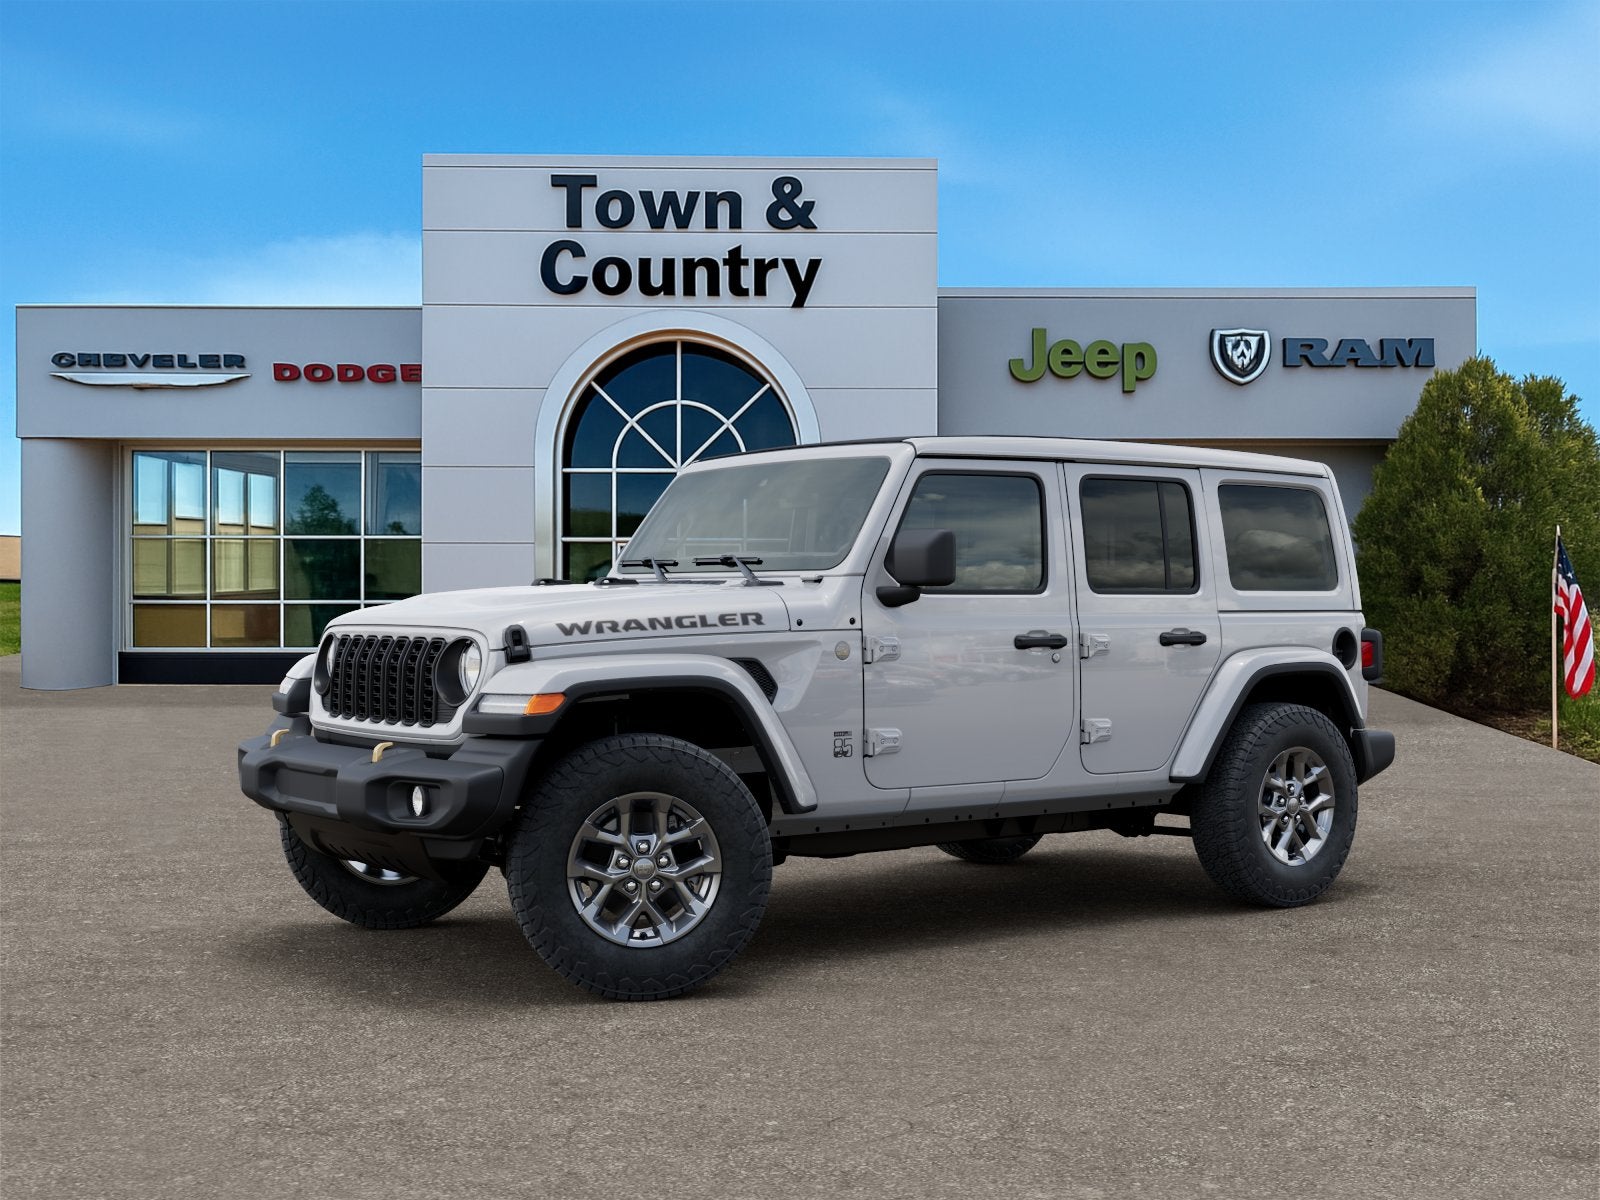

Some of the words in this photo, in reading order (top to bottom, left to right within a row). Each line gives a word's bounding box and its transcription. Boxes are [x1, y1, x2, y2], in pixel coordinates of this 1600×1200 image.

[550, 174, 743, 229] Town
[765, 176, 818, 230] &
[540, 239, 822, 308] Country
[273, 363, 422, 383] DODGE
[1009, 328, 1158, 393] Jeep
[1283, 337, 1435, 368] RAM
[556, 611, 765, 637] WRANGLER
